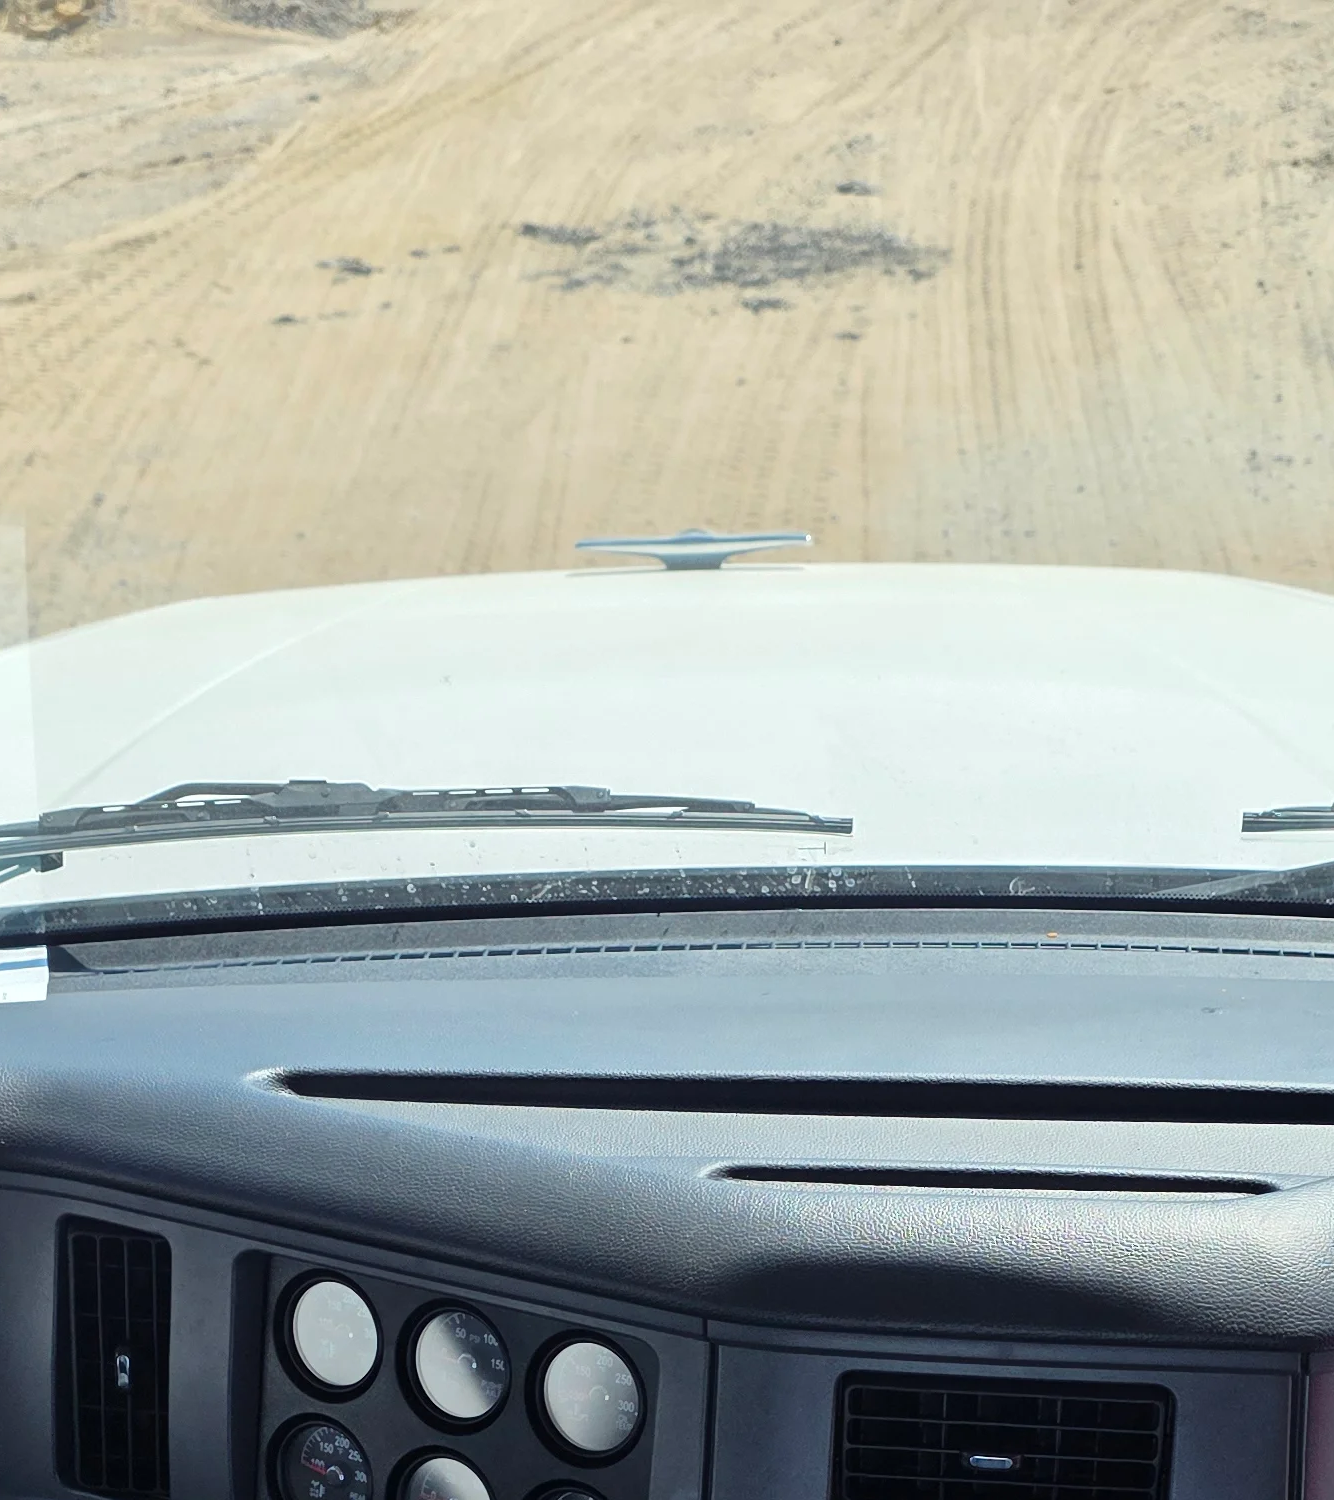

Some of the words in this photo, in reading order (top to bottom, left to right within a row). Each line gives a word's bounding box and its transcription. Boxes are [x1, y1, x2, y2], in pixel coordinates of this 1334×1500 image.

[456, 1327, 467, 1339] 50
[618, 1399, 635, 1412] 300
[319, 1441, 334, 1454] 150
